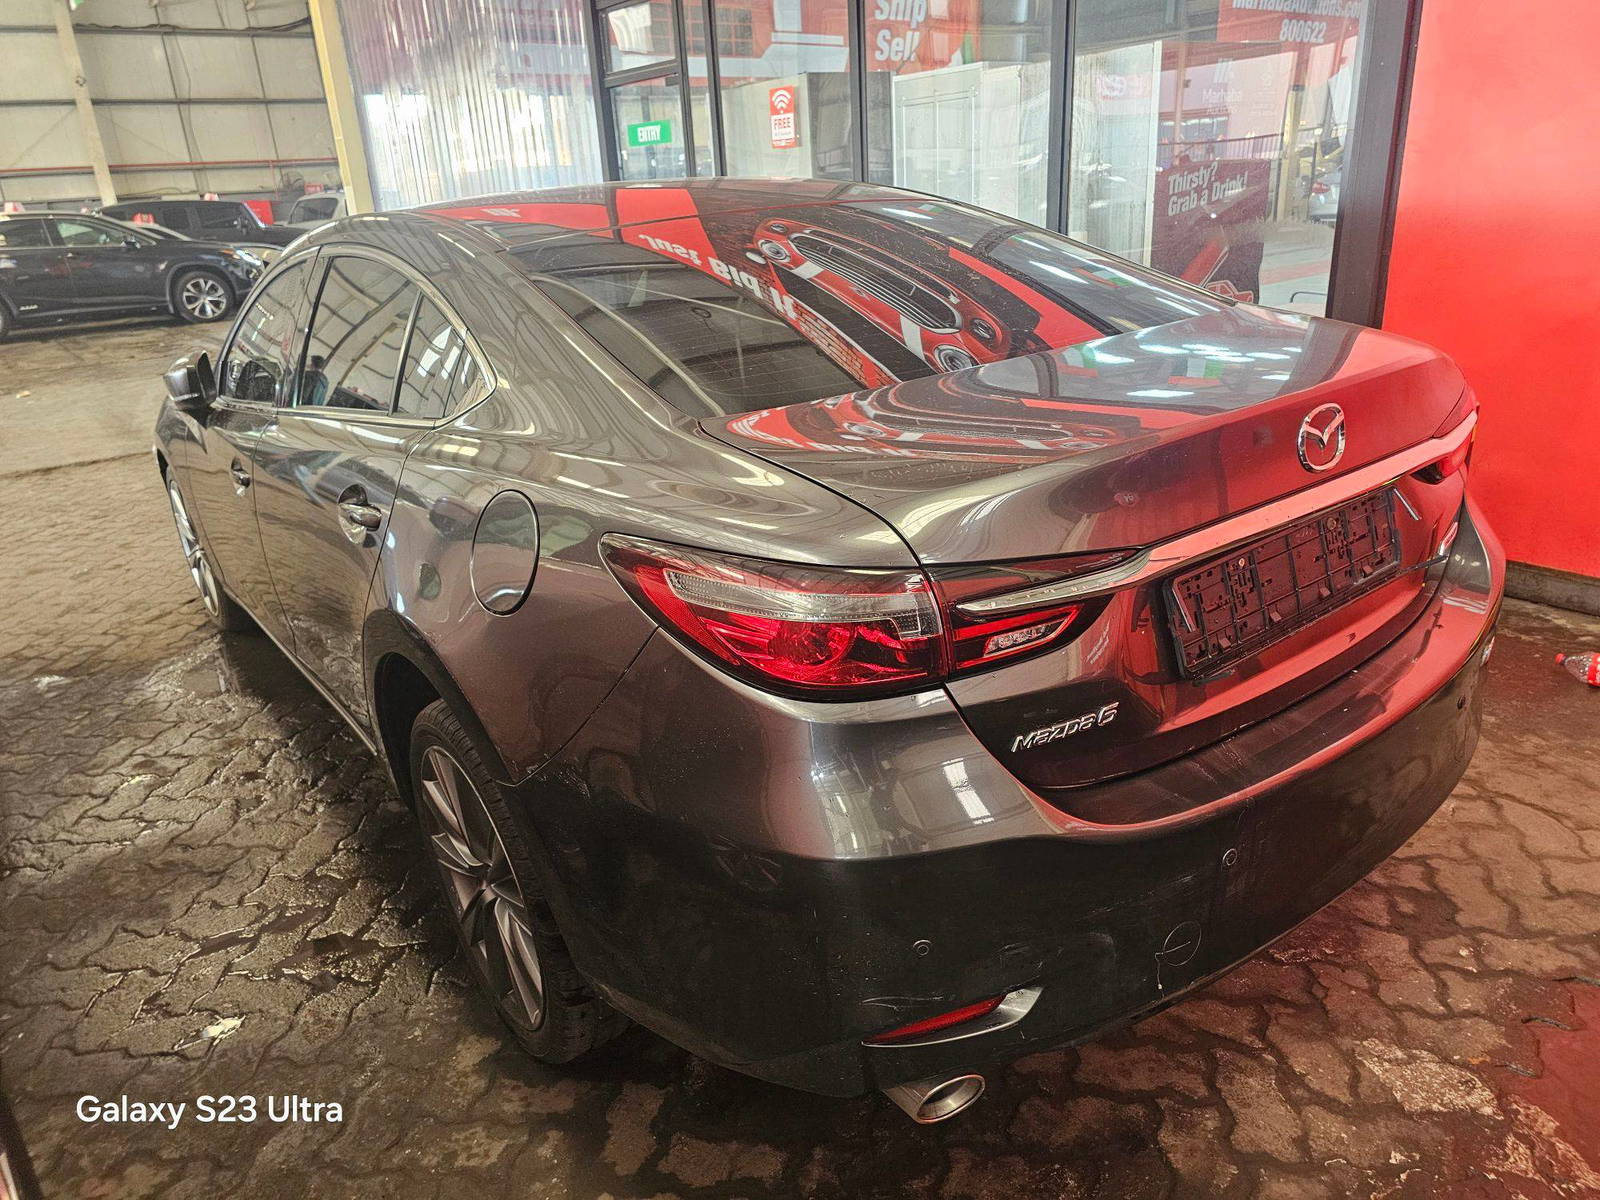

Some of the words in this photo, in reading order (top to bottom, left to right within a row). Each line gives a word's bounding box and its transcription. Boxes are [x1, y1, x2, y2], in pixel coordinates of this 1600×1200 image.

[1279, 18, 1327, 43] 800622
[875, 29, 920, 61] Sell
[637, 125, 661, 142] ENTRY
[773, 116, 791, 130] FREE
[1168, 162, 1218, 195] Thirsty?
[1168, 190, 1198, 216] Grab
[1200, 189, 1209, 206] a
[1212, 171, 1248, 202] Drink!
